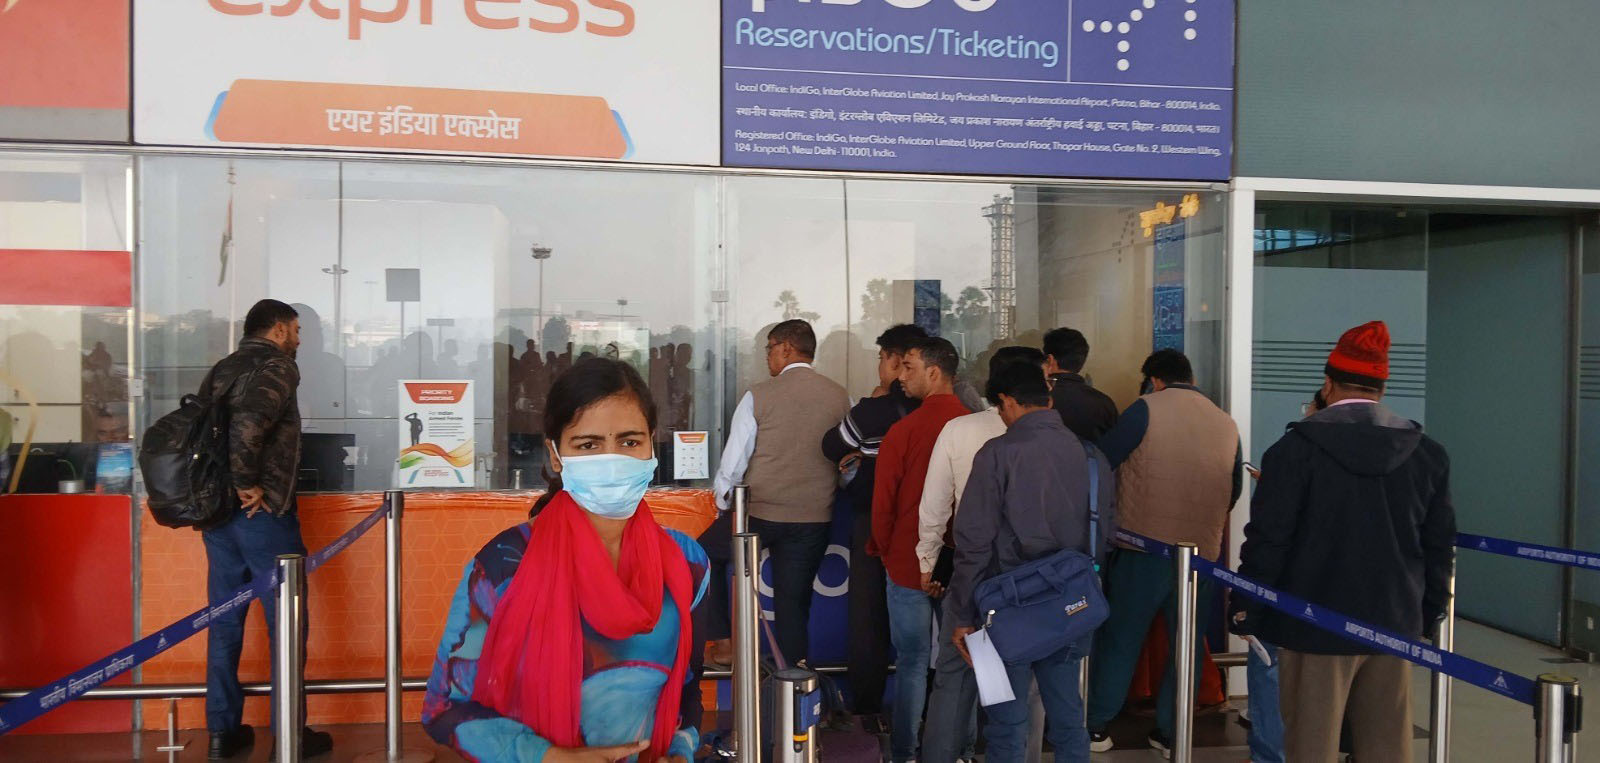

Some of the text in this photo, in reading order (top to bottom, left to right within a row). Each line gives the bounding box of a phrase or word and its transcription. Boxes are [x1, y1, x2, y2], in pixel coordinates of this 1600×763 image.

[735, 17, 1059, 68] Reservations/Ticketing
[735, 82, 759, 92] Local
[759, 83, 788, 94] Office:
[790, 84, 822, 96] IndiGo,
[823, 86, 870, 97] InterGlobe
[871, 88, 906, 99] Aviation
[956, 92, 990, 102] Prakash
[990, 94, 1027, 105] Narayan
[1027, 95, 1080, 105] International
[1139, 99, 1161, 109] Bihar
[326, 108, 375, 133] एयर
[377, 105, 440, 136] इंडिया
[736, 105, 767, 117] स्थानीय
[735, 129, 785, 141] Registered
[785, 131, 816, 142] Office:
[816, 132, 848, 144] IndiGo,
[849, 134, 897, 145] InterGlobe
[898, 136, 934, 146] Aviation
[968, 139, 995, 149] Upper
[995, 140, 1029, 149] Ground
[1053, 141, 1083, 152] Thapar
[1112, 143, 1136, 152] Gate
[1161, 145, 1197, 154] Western
[792, 145, 813, 154] New
[814, 146, 836, 155] Delhi
[1344, 621, 1443, 667] AIRPORTS AUTHORITY OF INDIA
